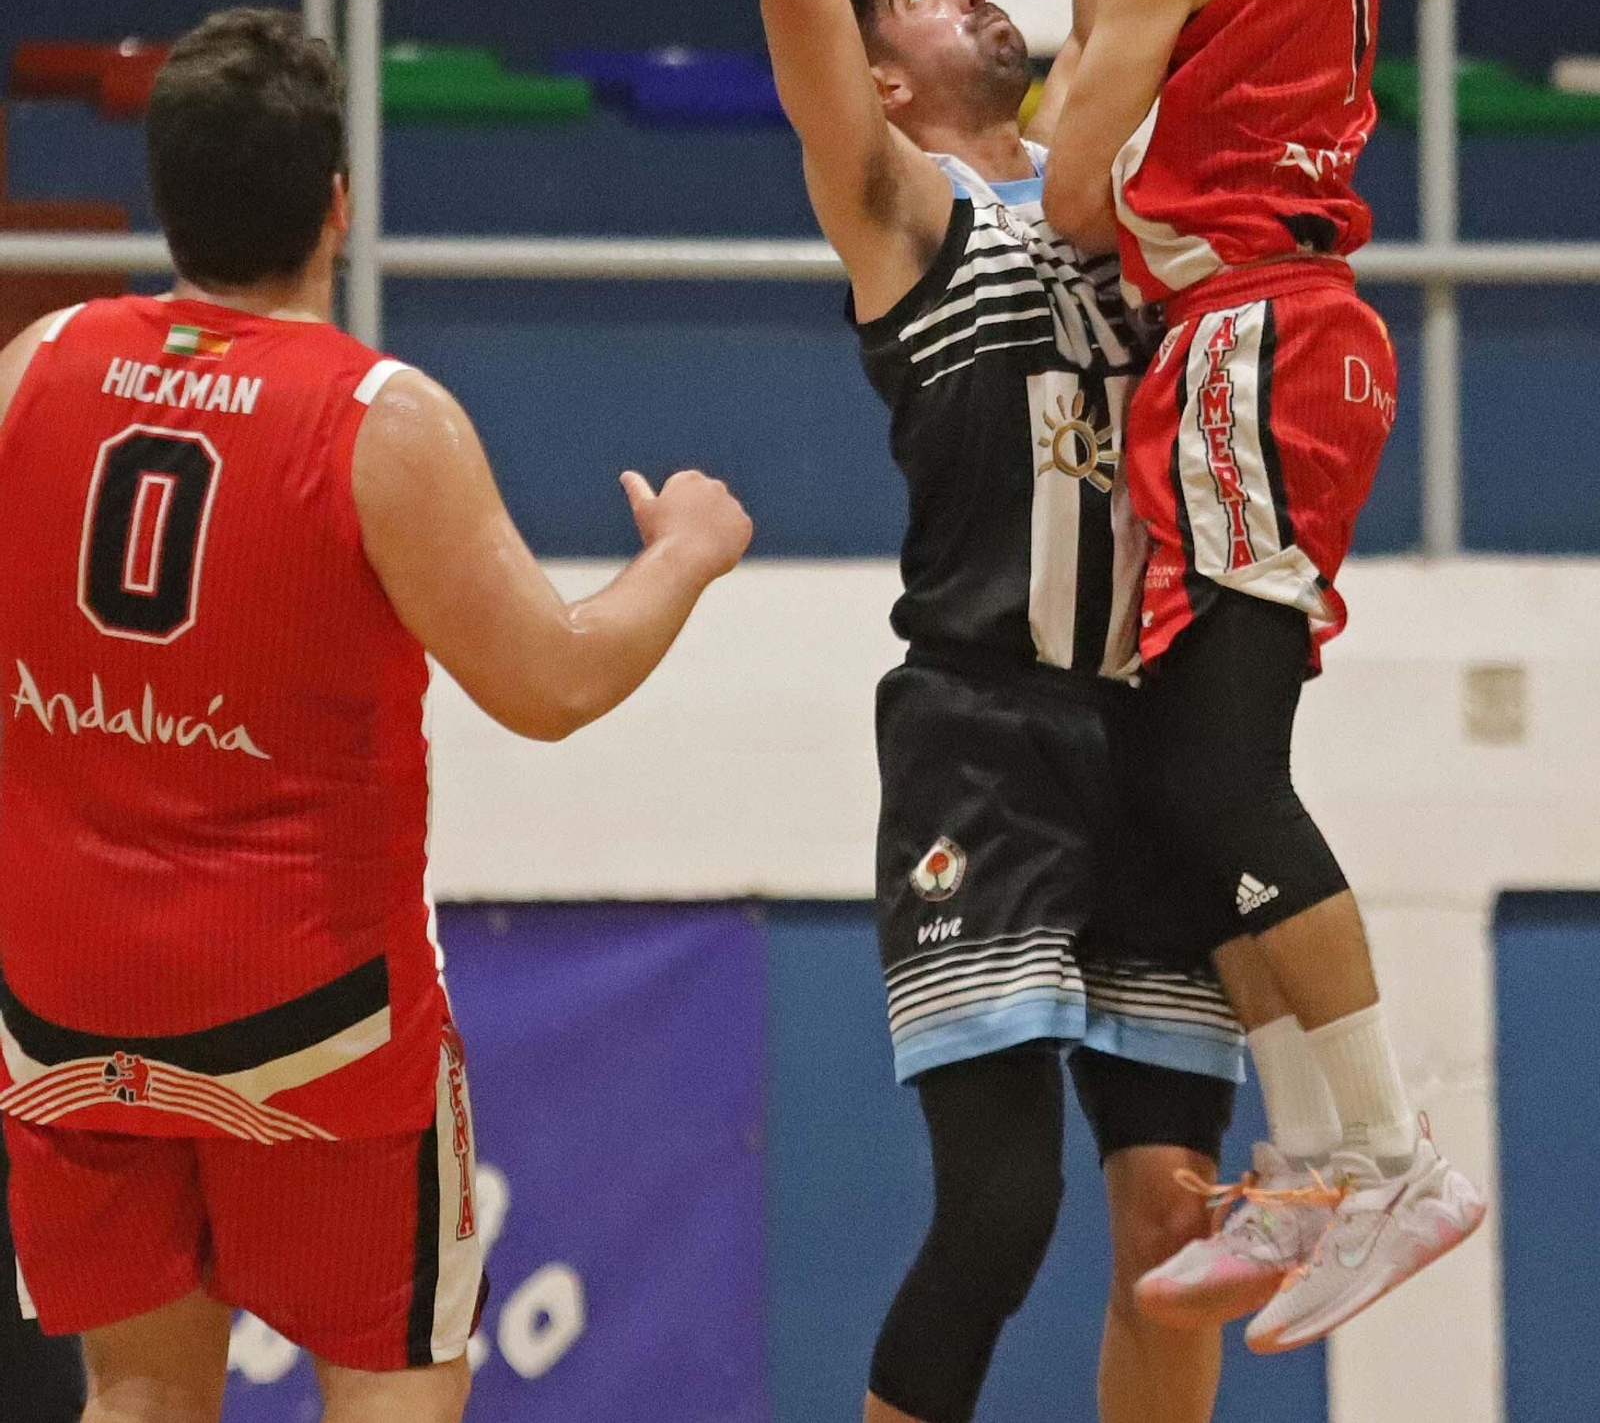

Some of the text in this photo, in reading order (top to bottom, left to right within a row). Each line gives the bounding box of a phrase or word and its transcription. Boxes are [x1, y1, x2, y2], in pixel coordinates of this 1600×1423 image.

[101, 356, 263, 415] HICKMAN
[1197, 313, 1257, 573] ALMERIA
[77, 423, 222, 645] 0
[10, 657, 273, 760] Andalucía
[917, 916, 963, 945] vive
[1235, 884, 1279, 915] adidas
